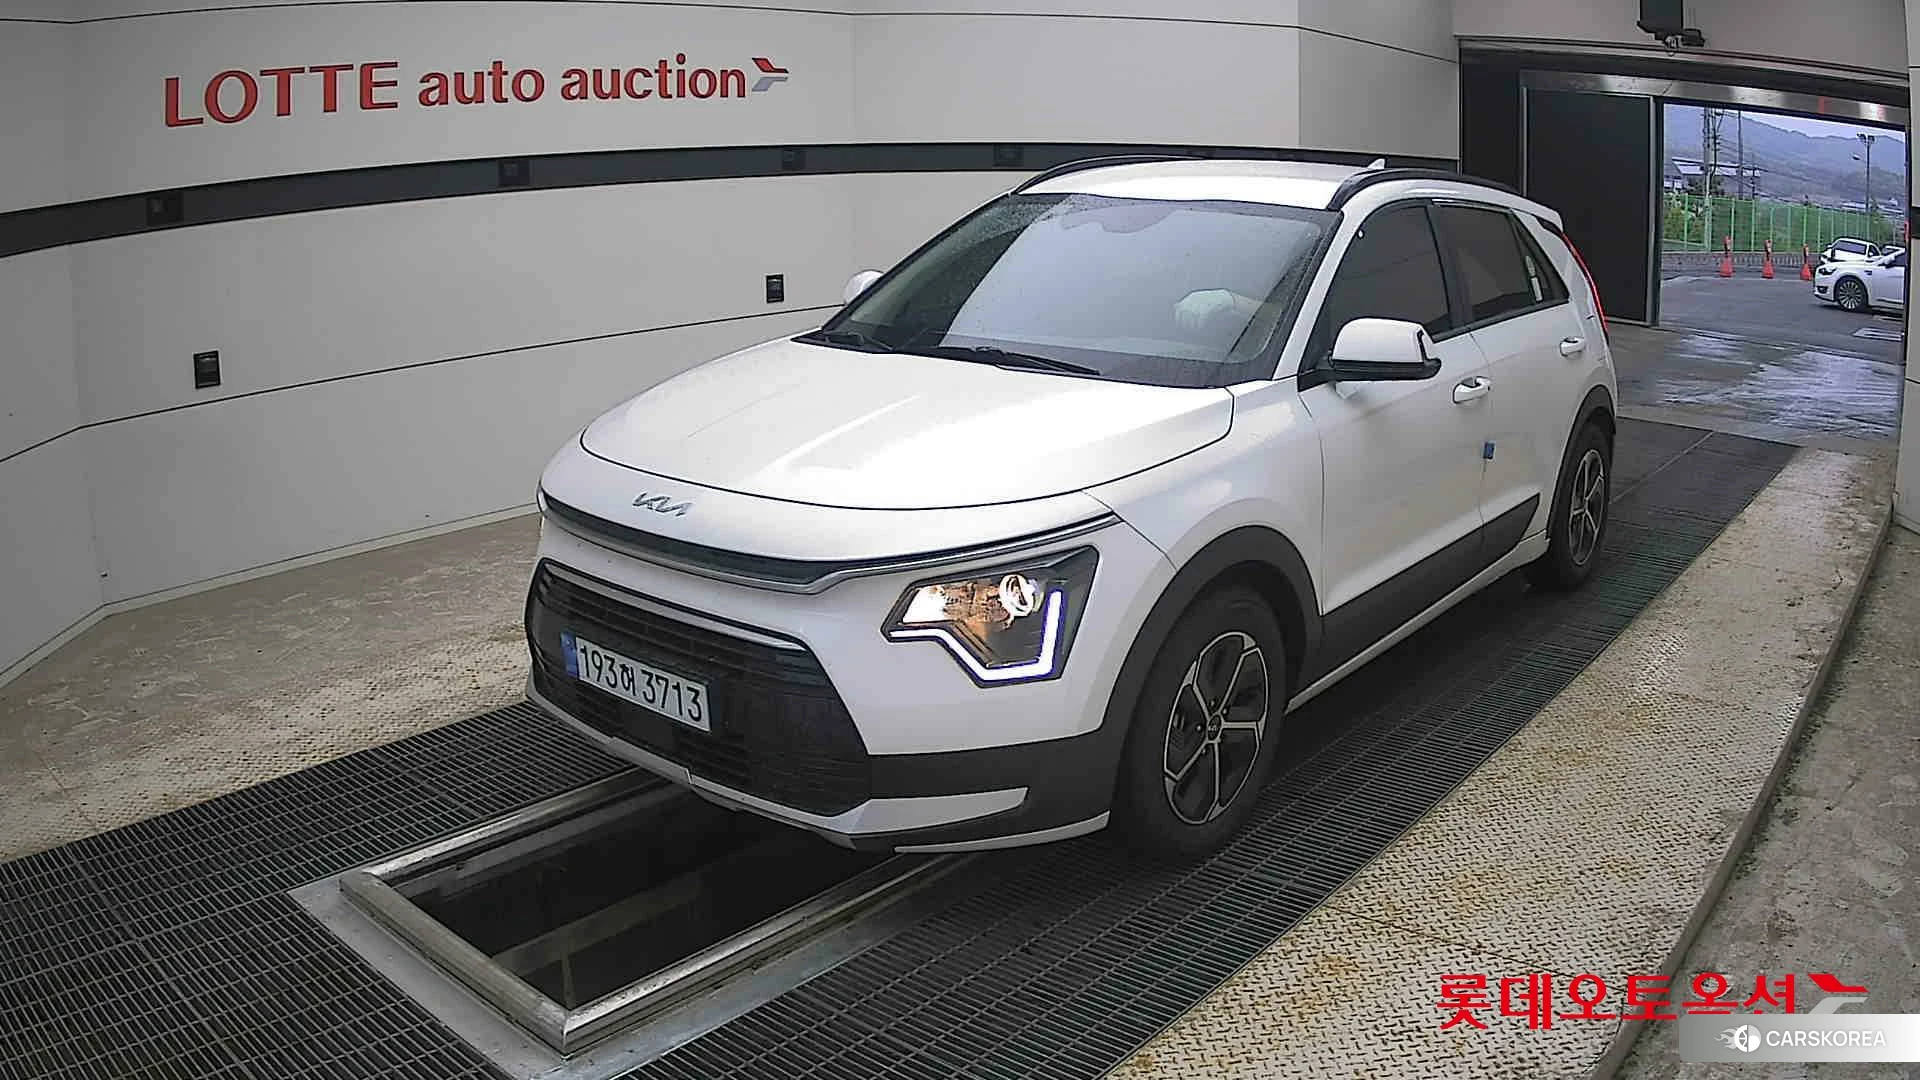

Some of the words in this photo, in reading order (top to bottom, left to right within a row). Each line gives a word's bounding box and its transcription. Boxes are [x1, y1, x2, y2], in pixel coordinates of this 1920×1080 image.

[165, 61, 399, 127] LOTTE
[418, 60, 545, 107] auto
[560, 53, 747, 100] auction
[580, 645, 636, 697] 193허
[641, 669, 702, 723] 3713
